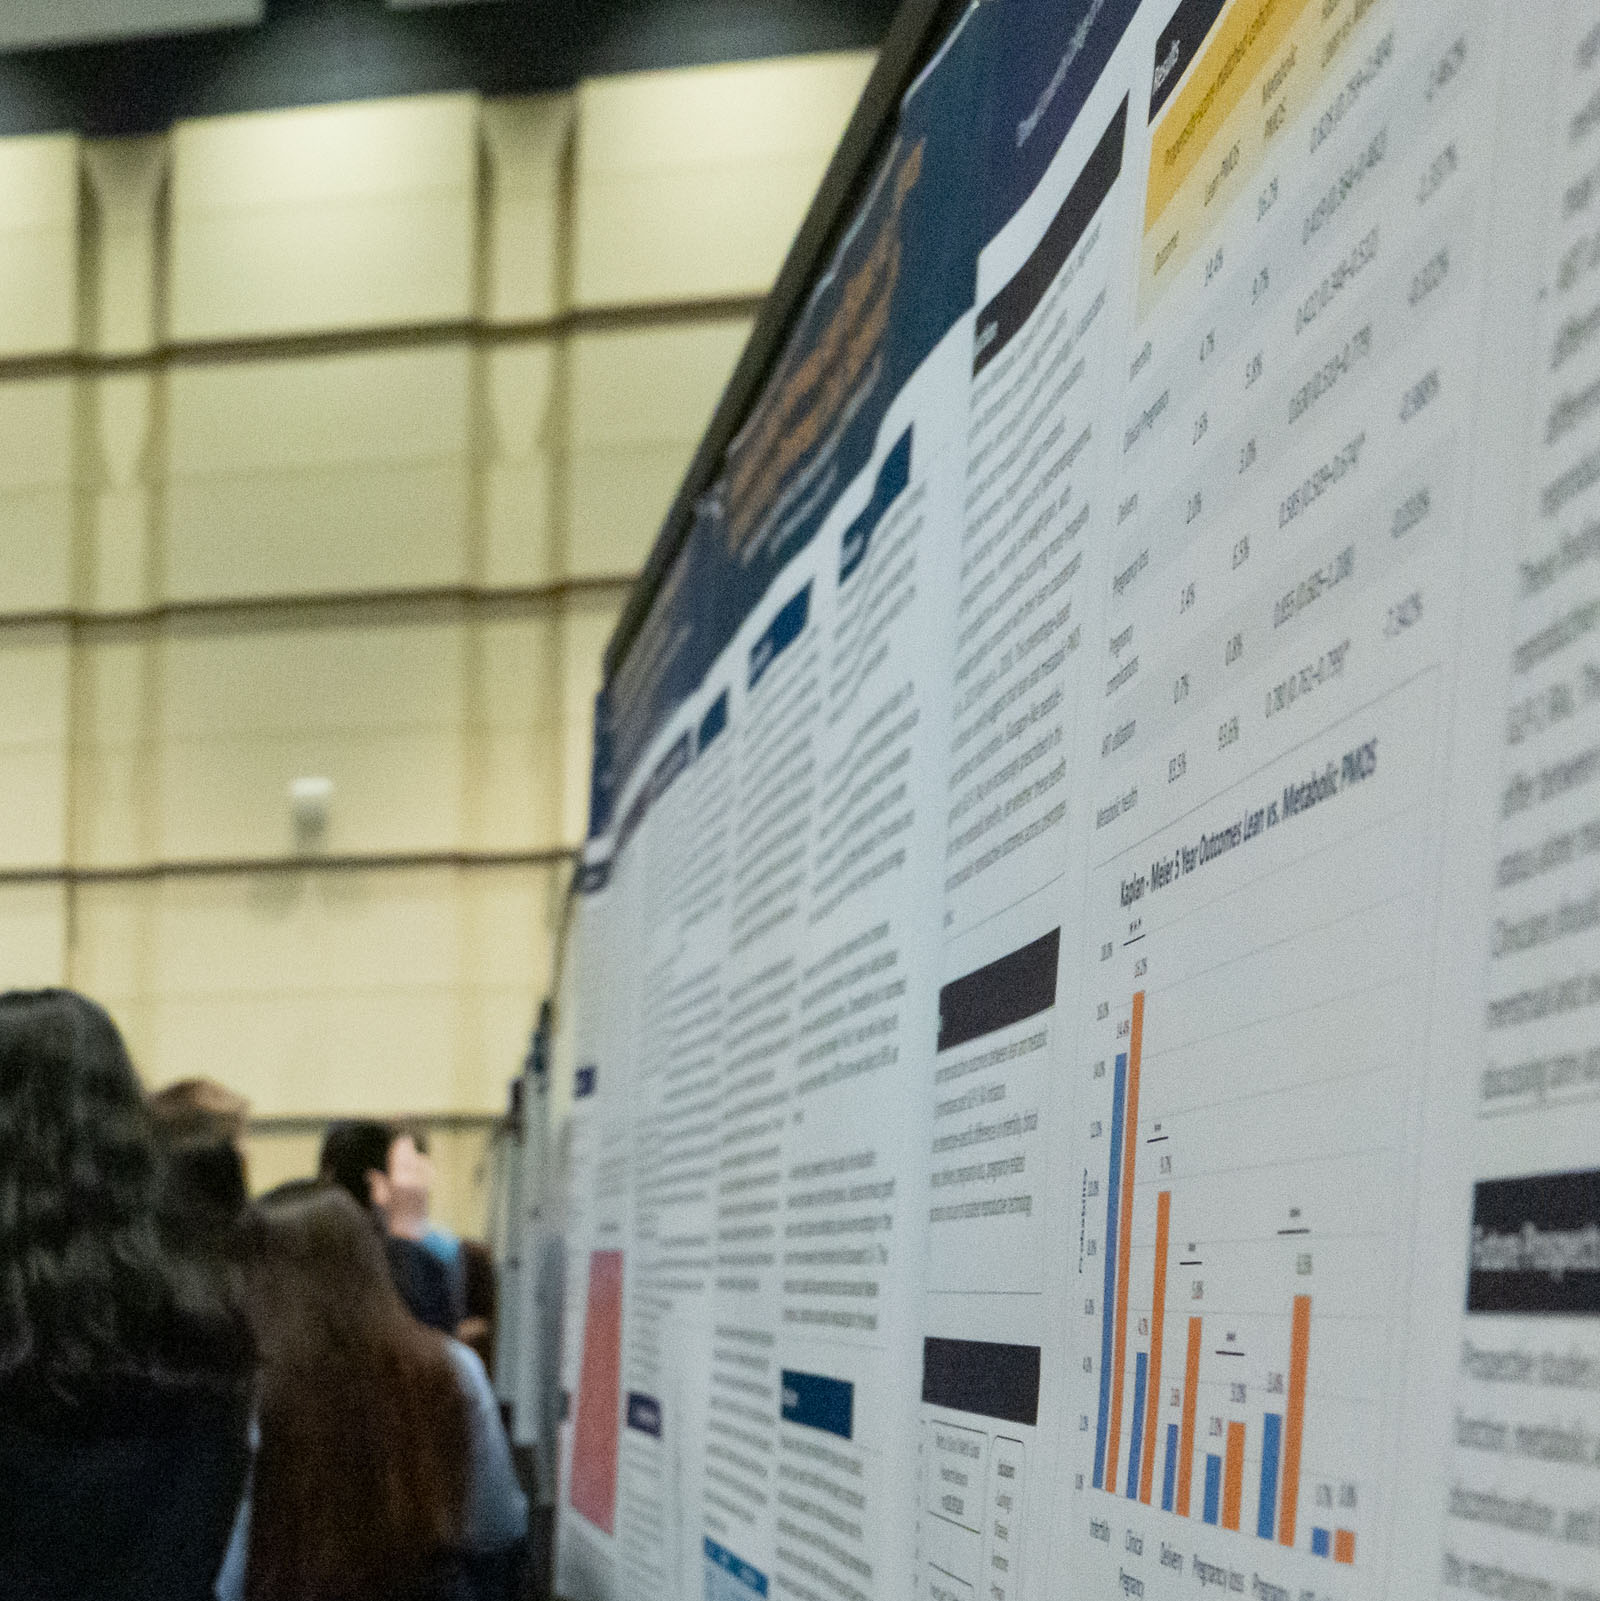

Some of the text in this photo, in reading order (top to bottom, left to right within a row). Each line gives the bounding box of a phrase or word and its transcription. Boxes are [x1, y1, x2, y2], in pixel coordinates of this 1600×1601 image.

[1120, 873, 1145, 911] Kaplan
[1151, 856, 1174, 893] Meier
[1181, 844, 1198, 876] Year
[1199, 821, 1243, 866] Outcomes
[1243, 808, 1265, 842] Lean
[1281, 762, 1339, 821] Metabolic
